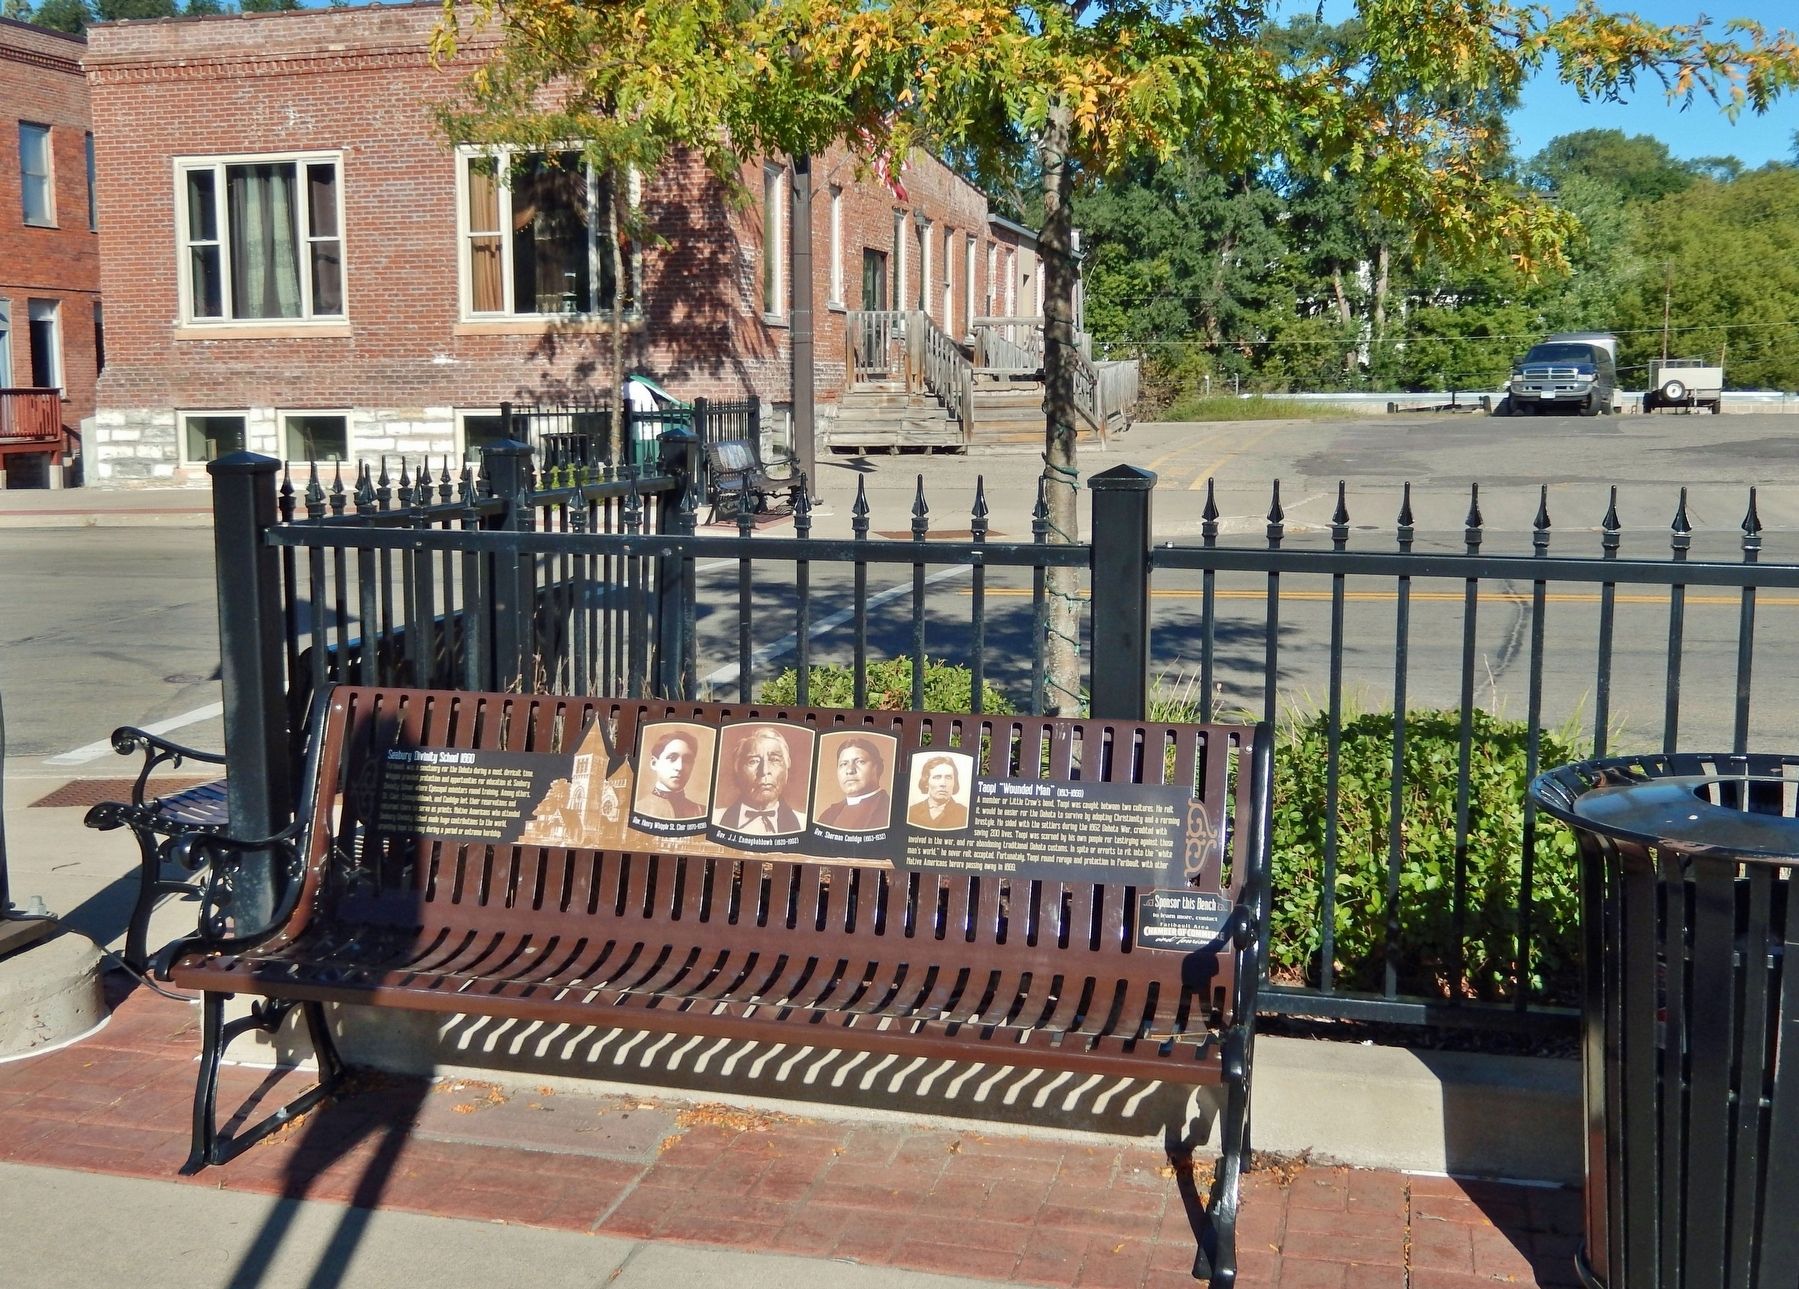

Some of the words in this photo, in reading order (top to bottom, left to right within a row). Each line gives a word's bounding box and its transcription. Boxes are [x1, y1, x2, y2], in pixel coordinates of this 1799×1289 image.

[388, 749, 412, 763] Seabury
[414, 750, 438, 764] Divinity
[439, 751, 460, 764] School
[978, 781, 997, 795] Taopi
[999, 782, 1033, 796] "Wounded
[1035, 784, 1055, 796] Man"
[1009, 797, 1024, 806] Little
[1024, 798, 1042, 807] Crow's
[1056, 799, 1070, 809] Taopi
[1071, 801, 1082, 809] was
[1121, 803, 1132, 811] two
[982, 806, 997, 815] would
[1029, 808, 1039, 818] the
[1039, 809, 1056, 819] Dakota
[1057, 810, 1064, 819] to
[1084, 812, 1091, 822] by
[1092, 813, 1113, 823] adopting
[1113, 813, 1144, 825] Christianity
[1144, 815, 1154, 824] and
[716, 830, 726, 839] Rev.
[1018, 819, 1030, 828] with
[1031, 819, 1041, 829] the
[1041, 820, 1061, 830] settlers
[1061, 821, 1078, 832] during
[1078, 822, 1089, 831] the
[1101, 823, 1119, 833] Dakota
[1133, 826, 1154, 835] credited
[1154, 827, 1168, 836] with
[814, 827, 823, 837] Rev.
[824, 831, 844, 841] Sherman
[844, 834, 862, 844] Coolidge
[974, 829, 989, 838] saving
[1015, 830, 1029, 840] Taopi
[1029, 832, 1040, 840] was
[1060, 833, 1068, 843] by
[1067, 833, 1076, 842] his
[1088, 834, 1104, 844] people
[927, 836, 933, 844] in
[934, 836, 943, 845] the
[956, 838, 966, 846] and
[1002, 840, 1029, 850] traditional
[1029, 841, 1047, 851] Dakota
[1076, 845, 1090, 854] spite
[1116, 847, 1124, 855] to
[1145, 848, 1154, 857] the
[906, 857, 923, 866] Native
[923, 857, 948, 868] Americans
[965, 861, 984, 871] passing
[907, 847, 922, 855] man's
[940, 848, 948, 856] he
[947, 849, 962, 857] never
[1026, 852, 1041, 863] Taopi
[1073, 856, 1084, 865] and
[1141, 859, 1155, 869] with
[1154, 860, 1169, 870] other
[1154, 894, 1181, 911] Sponsor
[1182, 896, 1196, 910] this
[1196, 897, 1217, 912] Bench
[1160, 912, 1176, 920] learn
[1143, 925, 1177, 937] CHAMBER
[1177, 927, 1186, 937] OF
